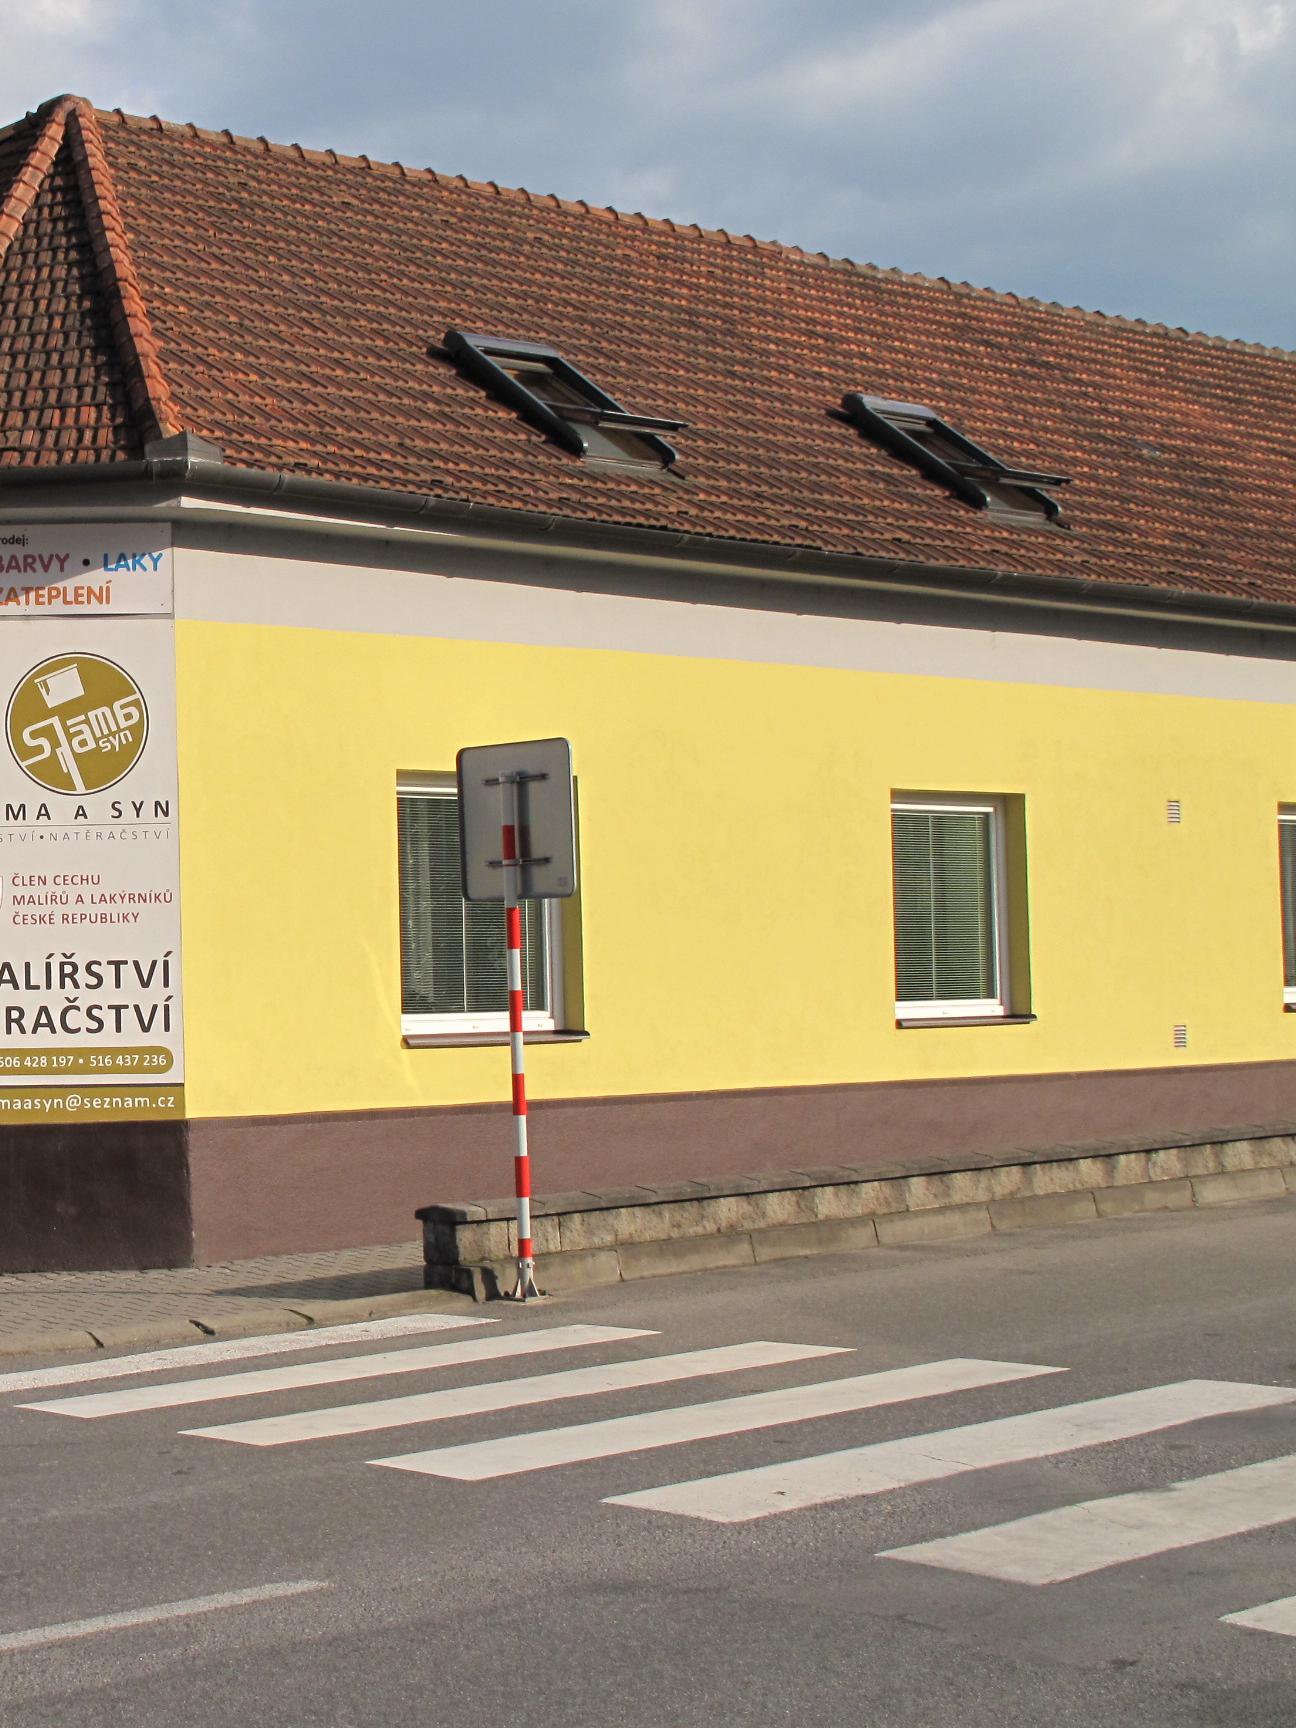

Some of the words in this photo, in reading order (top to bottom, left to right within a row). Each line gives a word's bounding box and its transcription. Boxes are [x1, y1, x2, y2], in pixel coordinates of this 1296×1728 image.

[102, 551, 165, 573] LAKY
[98, 729, 134, 753] syn
[73, 804, 89, 821] A
[110, 799, 171, 820] SYN
[11, 872, 48, 888] ČLEN
[52, 873, 102, 887] CECHU
[12, 890, 70, 906] MALÍŘŮ
[74, 893, 86, 906] A
[89, 889, 174, 905] LAKÝRNÍKŮ
[12, 910, 57, 926] ČESKÉ
[61, 911, 141, 926] REPUBLIKY
[23, 1055, 48, 1068] 428
[51, 1055, 74, 1068] 197
[89, 1054, 113, 1067] 516
[115, 1054, 140, 1067] 437
[142, 1053, 167, 1067] 236
